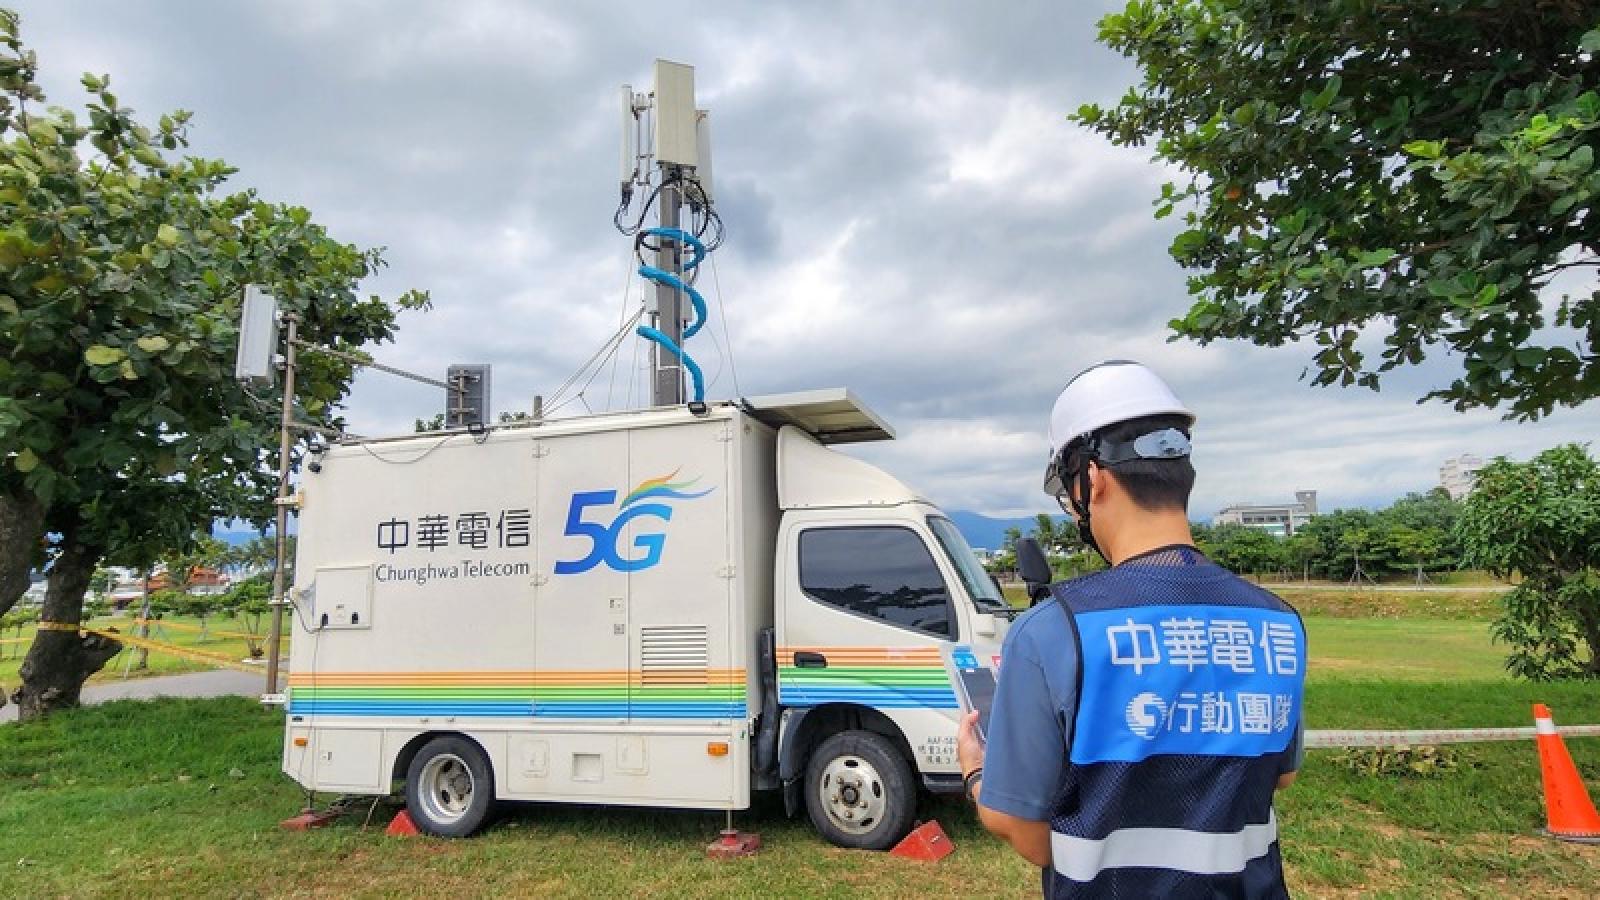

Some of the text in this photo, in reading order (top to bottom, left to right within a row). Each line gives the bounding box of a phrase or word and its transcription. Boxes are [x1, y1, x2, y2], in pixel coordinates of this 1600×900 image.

[377, 509, 532, 555] 中華電信
[553, 489, 674, 575] 5G
[375, 559, 530, 585] Chunghwa Telecom
[1106, 616, 1297, 675] 中華電信
[1167, 690, 1293, 734] 行動團隊
